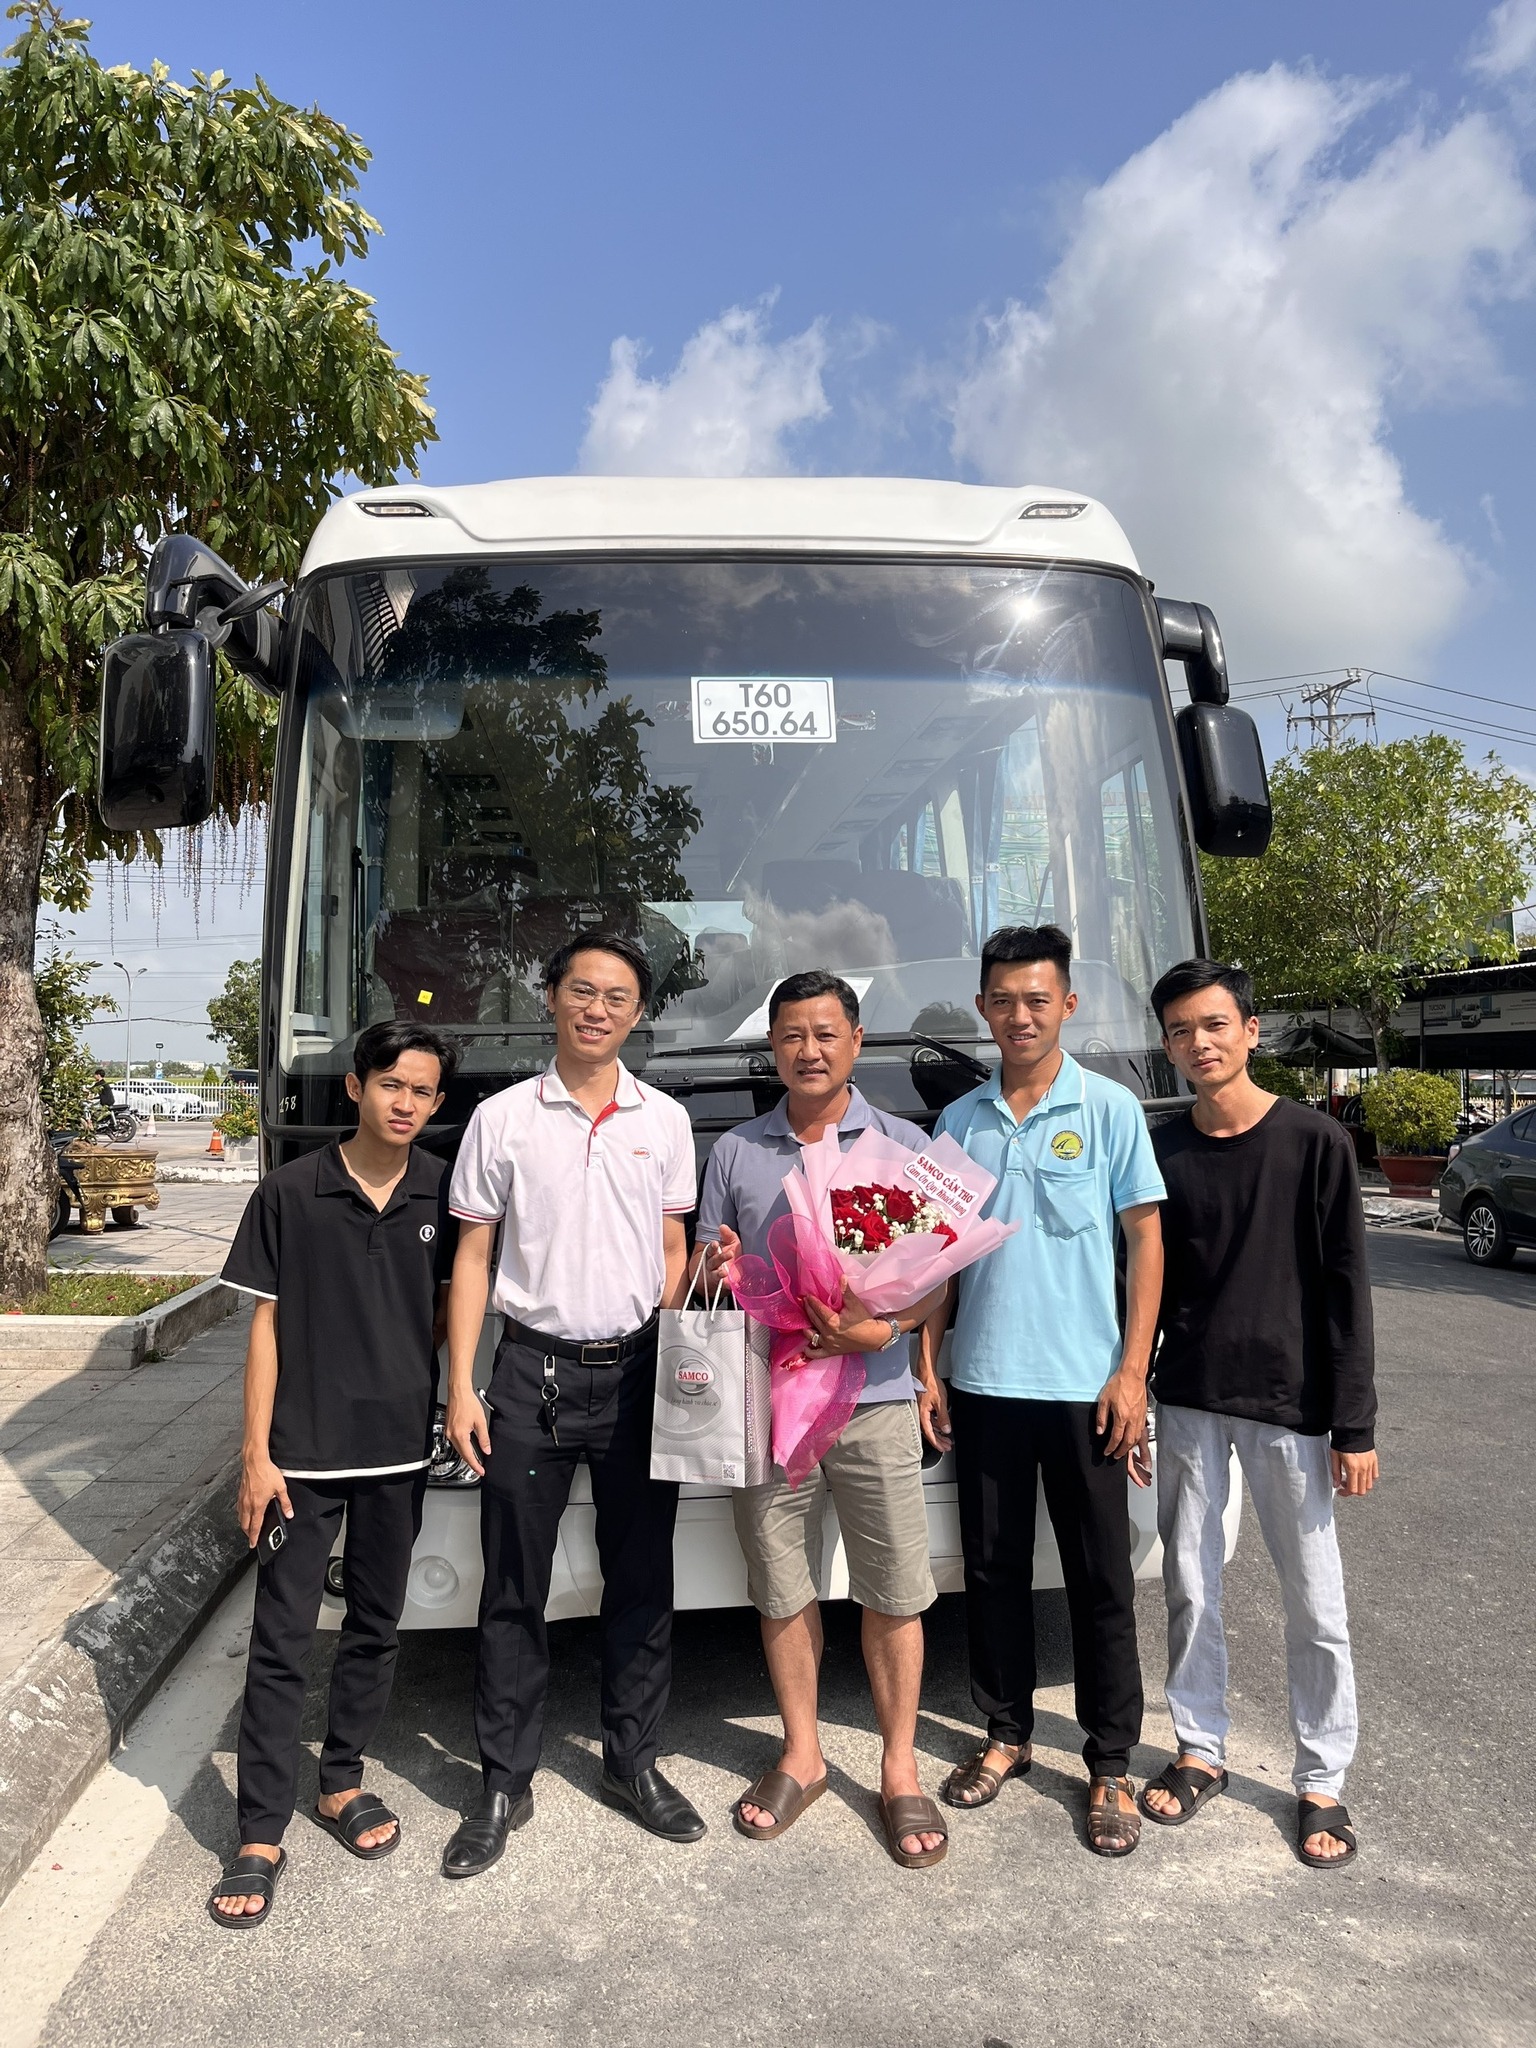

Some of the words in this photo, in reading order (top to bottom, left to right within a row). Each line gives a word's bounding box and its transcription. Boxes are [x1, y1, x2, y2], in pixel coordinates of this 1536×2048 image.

[739, 683, 791, 708] T60
[712, 710, 818, 736] 650.64
[917, 1156, 944, 1181] SAMCO
[957, 1188, 976, 1204] THƠ
[678, 1370, 709, 1382] SAMCO
